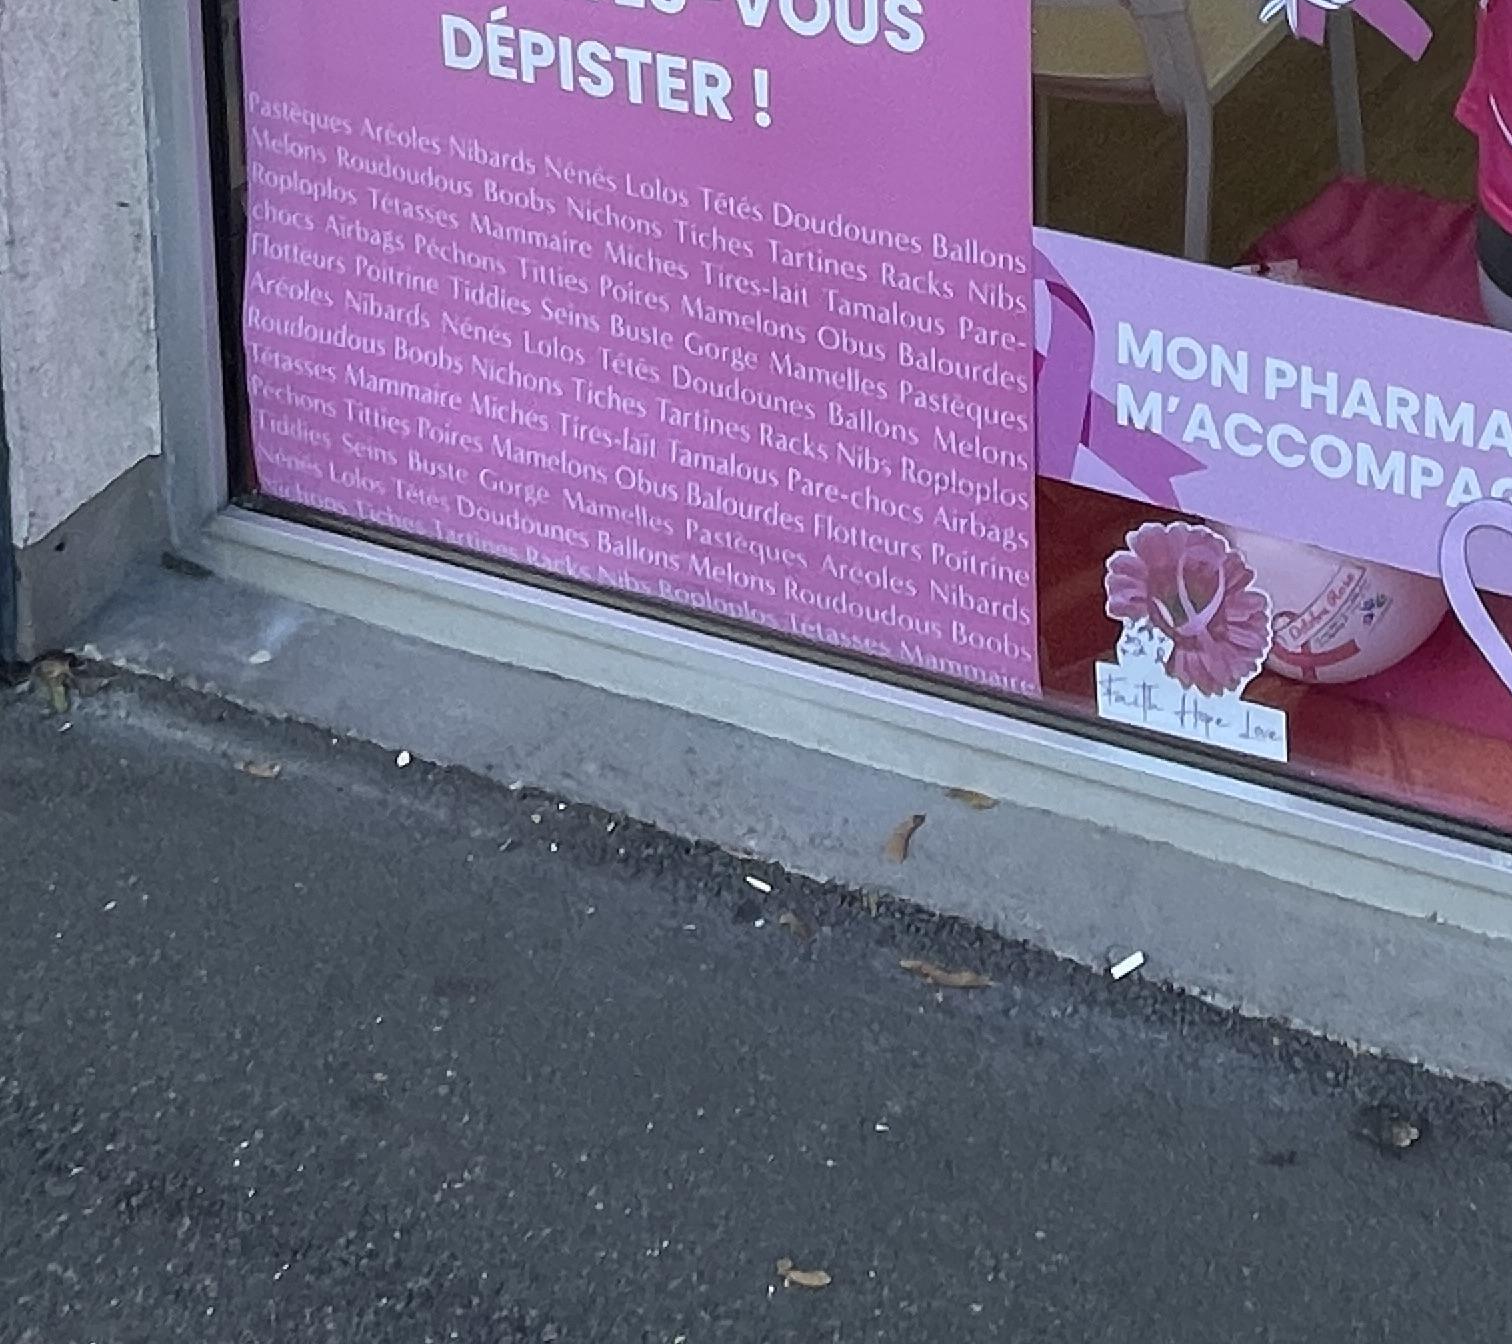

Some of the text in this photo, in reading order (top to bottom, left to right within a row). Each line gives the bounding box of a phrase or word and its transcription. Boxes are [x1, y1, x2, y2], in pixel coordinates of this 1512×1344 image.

[440, 5, 773, 129] DÉPISTER !
[244, 91, 1027, 273] Pastèques Aréoles Nibards Nénés Lolos Tétés Doudounes Ballons
[244, 266, 1031, 469] Aréoles Nibards Nénés Lolos Tétés Doudounes Ballons Melons
[1117, 321, 1248, 395] MON
